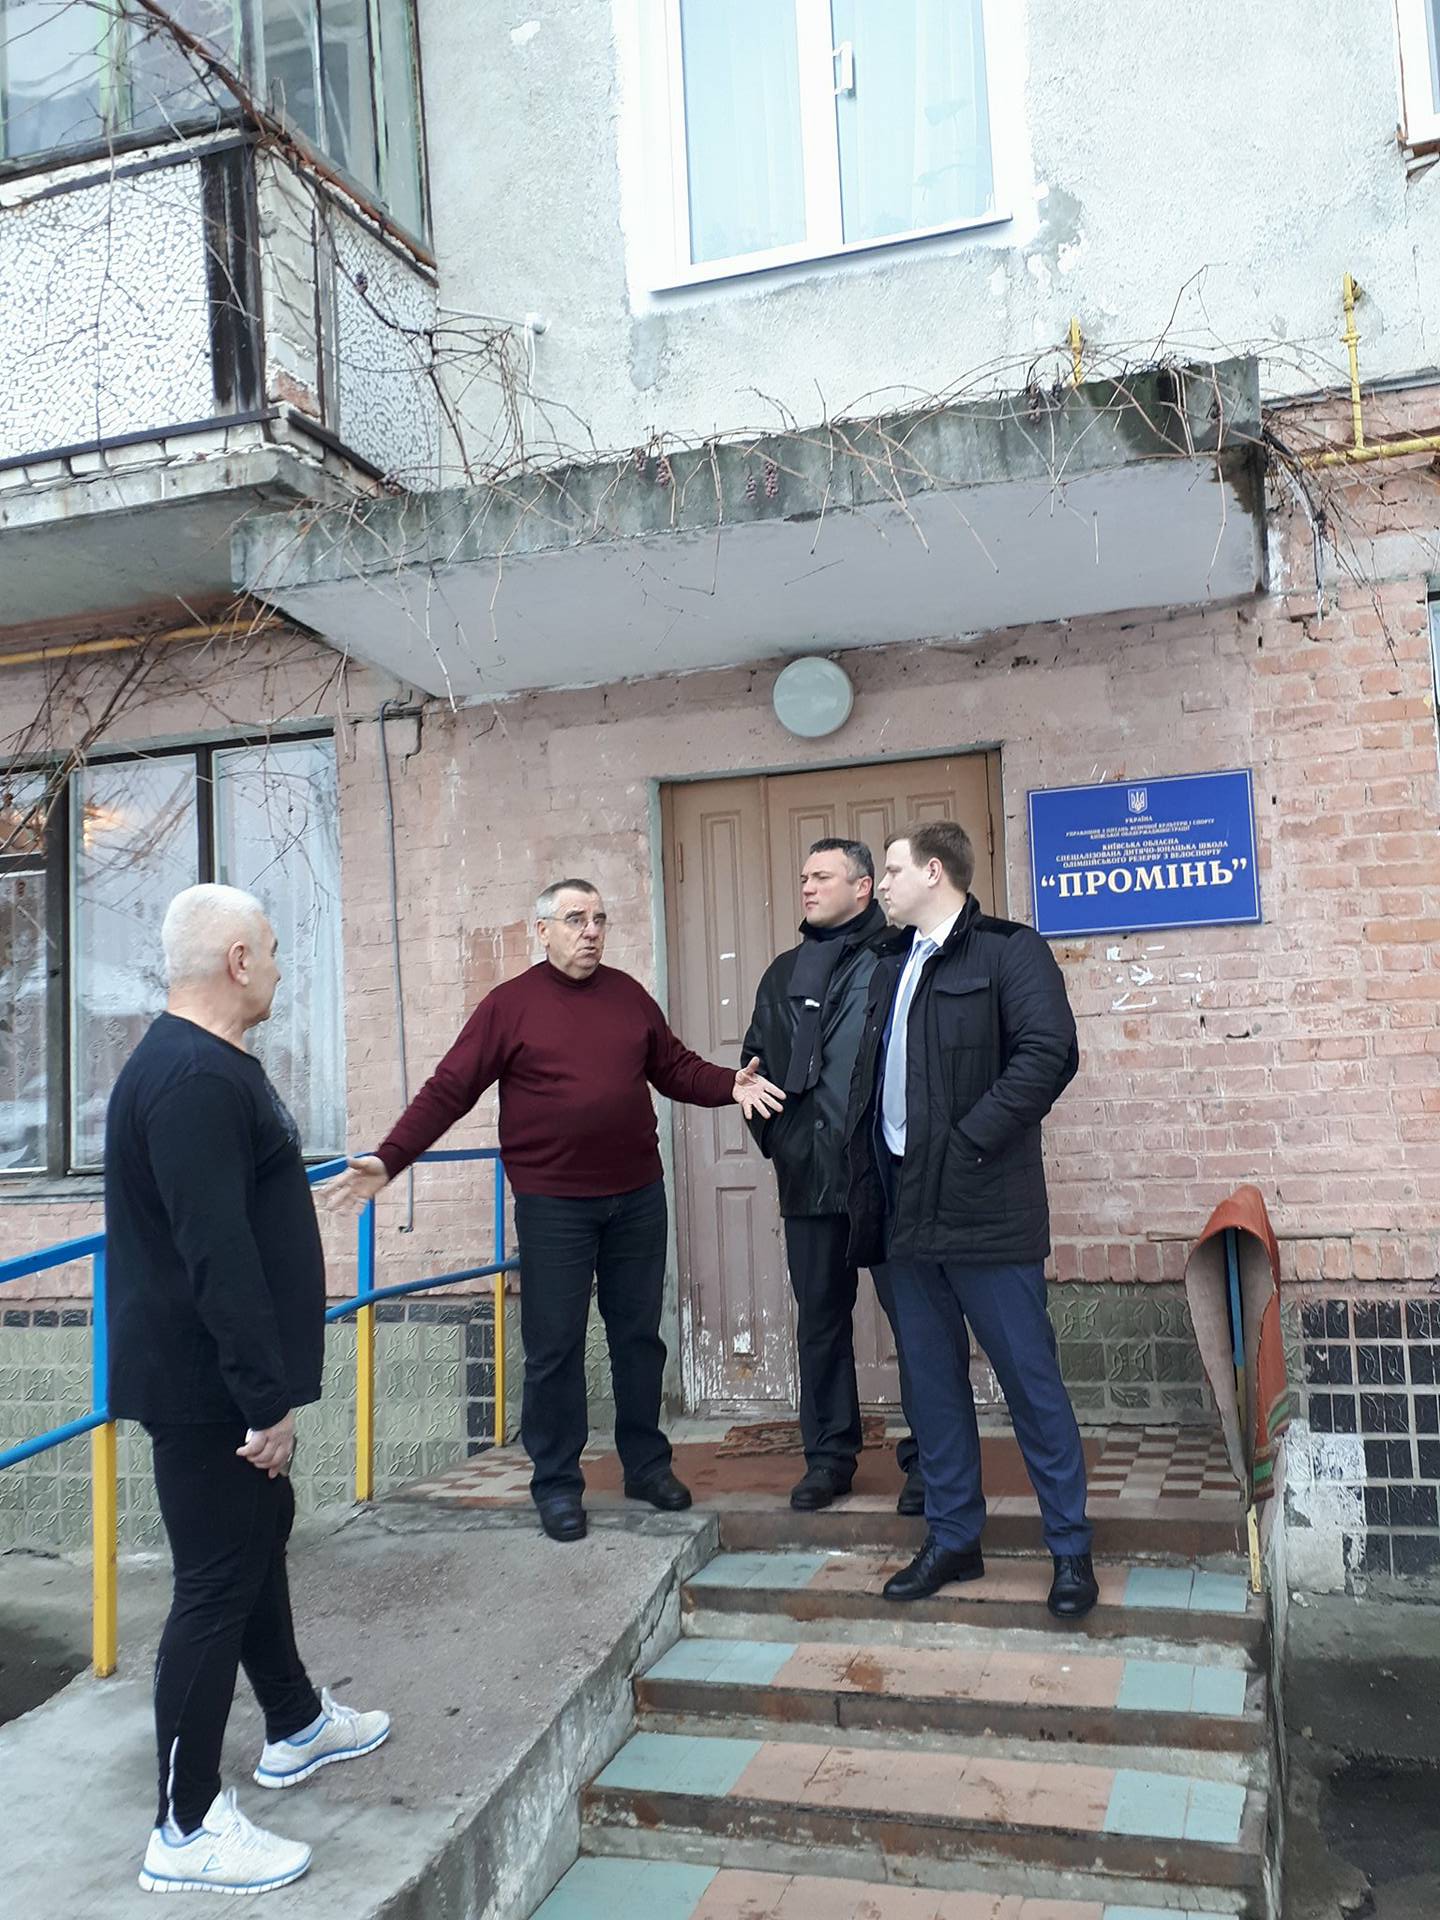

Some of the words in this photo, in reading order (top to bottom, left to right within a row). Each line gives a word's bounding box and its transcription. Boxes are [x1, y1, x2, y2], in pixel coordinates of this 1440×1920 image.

[1125, 816, 1153, 824] УКРАЇНА
[1056, 850, 1122, 862] СПЕЦІАЛІЗОВАНА
[1123, 843, 1197, 857] ДИТЯЧО-ЮНАЦЬКА
[1198, 840, 1228, 850] ШКОЛА
[1102, 841, 1141, 851] КИЇВСЬКА
[1142, 837, 1179, 848] ОБЛАСНА
[1063, 855, 1127, 868] ОЛІМПІЙСЬКОГО
[1128, 852, 1161, 863] РЕЗЕРВУ
[1170, 847, 1222, 859] ВЕЛОСПОРТУ
